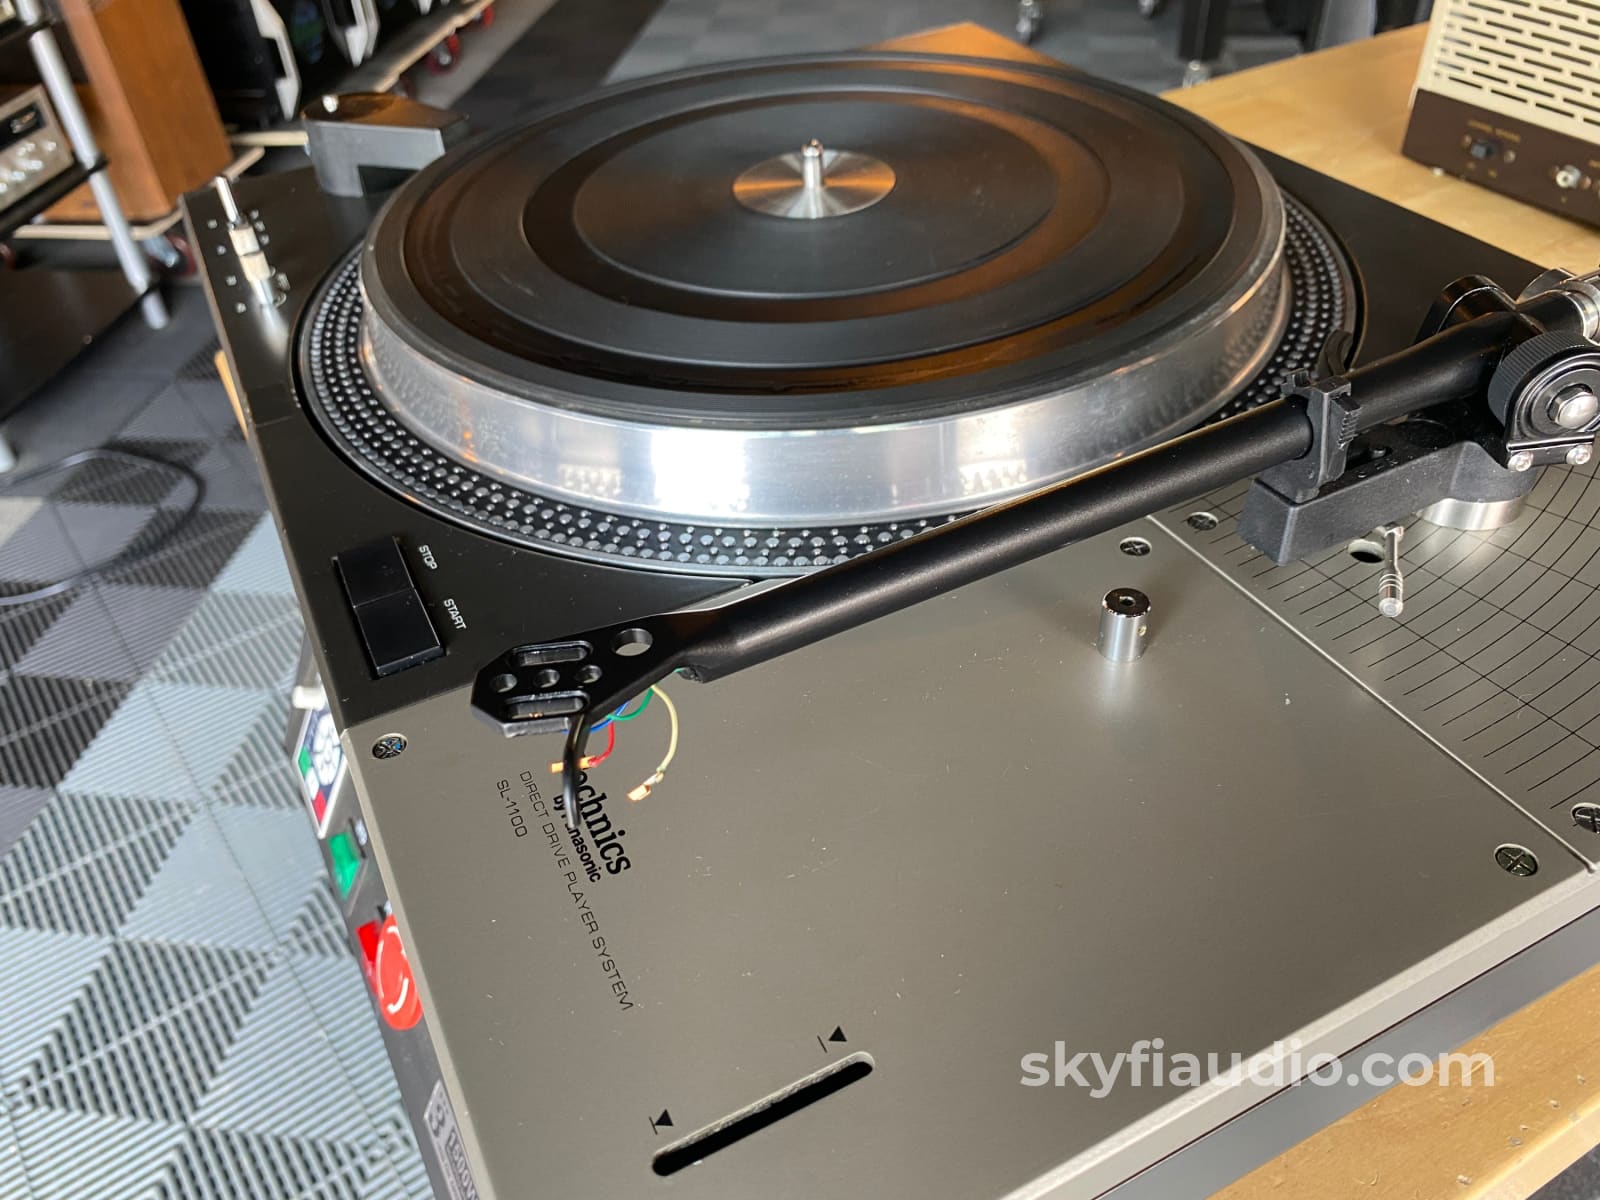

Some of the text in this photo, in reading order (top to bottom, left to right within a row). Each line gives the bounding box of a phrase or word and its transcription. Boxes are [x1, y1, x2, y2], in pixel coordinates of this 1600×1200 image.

[418, 544, 438, 570] STOP
[443, 598, 467, 630] START
[496, 779, 529, 838] SL-1100
[553, 794, 602, 883] by nasonic
[573, 755, 632, 876] echnics
[519, 770, 634, 1012] DIRECT DRIVE PLAYER SYSTEM
